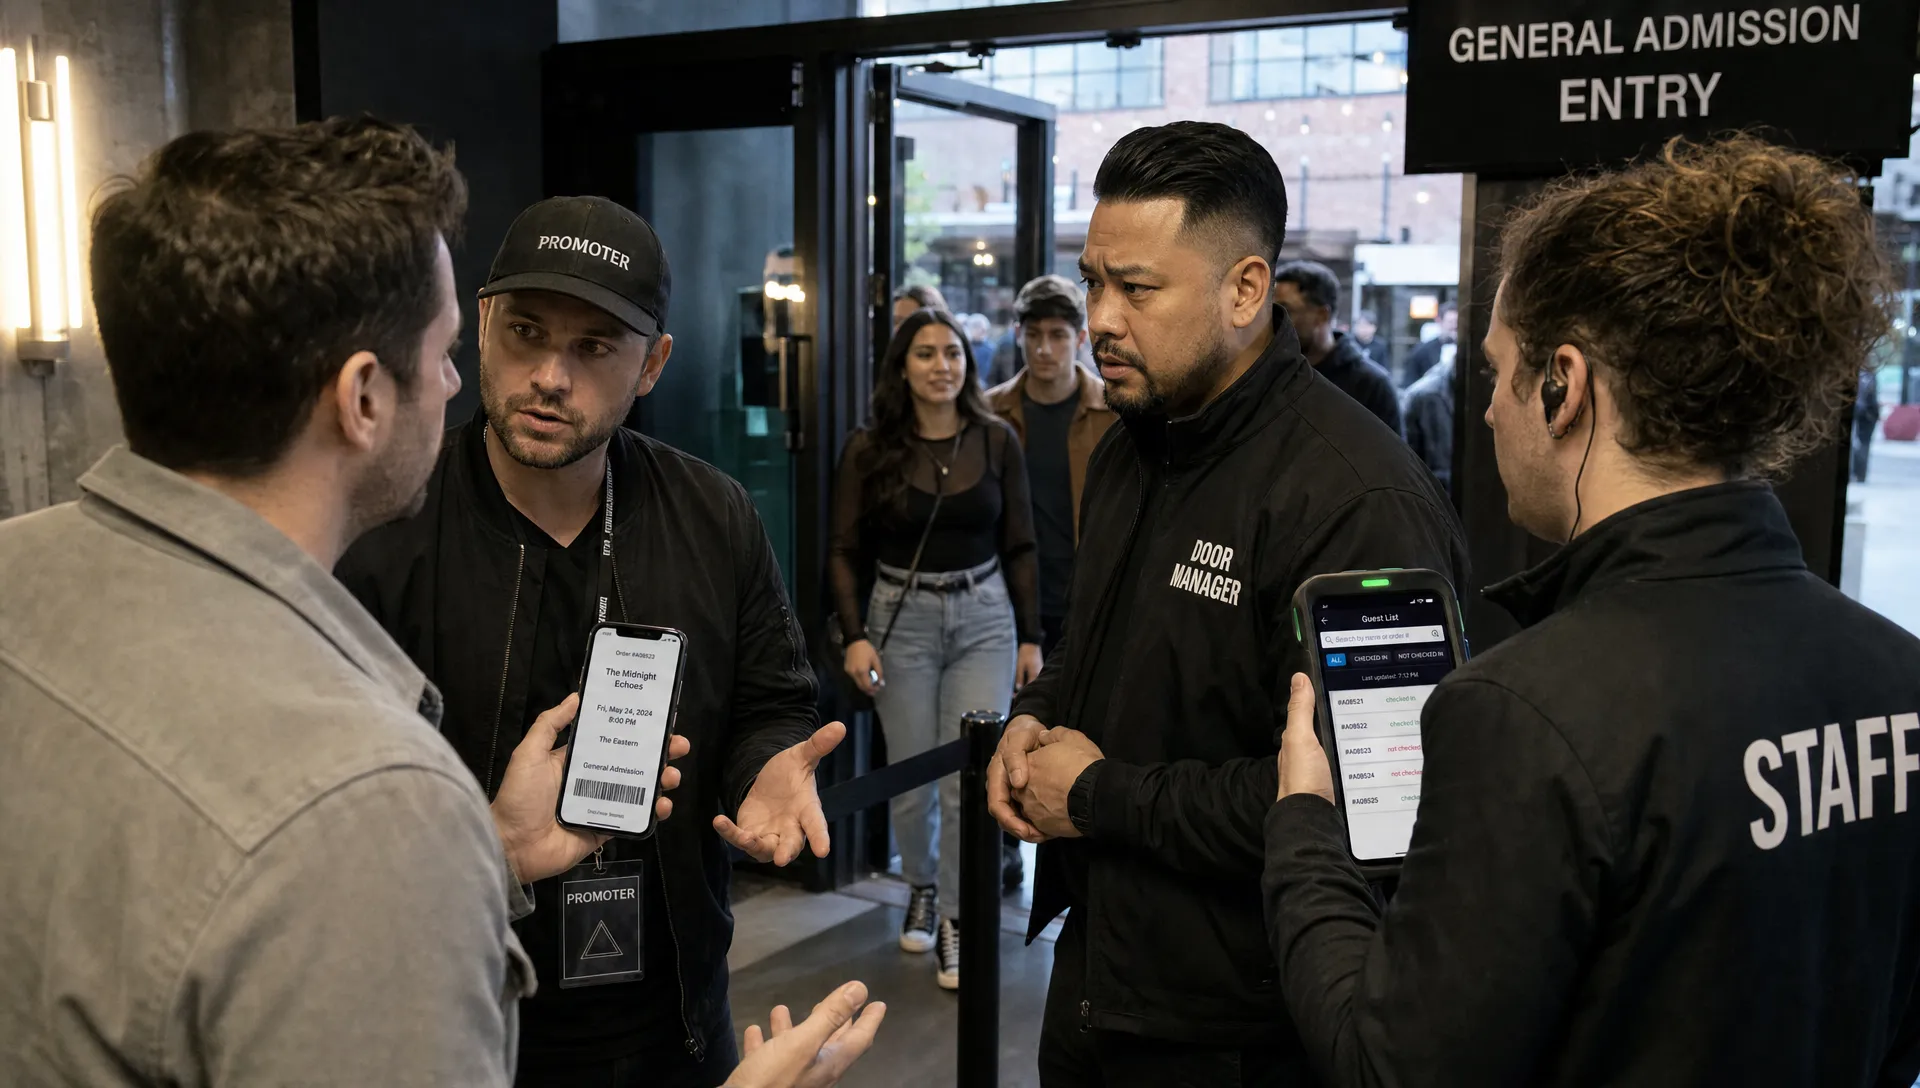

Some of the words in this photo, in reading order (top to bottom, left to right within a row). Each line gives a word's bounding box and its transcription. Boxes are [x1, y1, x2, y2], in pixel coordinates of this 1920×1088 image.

[1449, 19, 1625, 64] GENERAL
[1634, 4, 1860, 56] ADMISSION
[1559, 72, 1722, 123] ENTRY
[537, 235, 630, 271] PROMOTER
[1190, 539, 1234, 572] DOOR
[1169, 563, 1242, 606] MANAGER
[1361, 615, 1384, 623] Guest
[1385, 614, 1399, 622] List
[1357, 635, 1364, 643] by
[615, 650, 632, 658] Order
[1331, 656, 1342, 664] ALL
[605, 667, 621, 677] The
[622, 670, 657, 682] Midnight
[614, 680, 644, 691] Echoes
[596, 704, 608, 713] Fri,
[609, 706, 624, 715] May
[624, 708, 635, 717] 24,
[636, 709, 653, 717] 2024
[608, 716, 624, 725] 8:00
[625, 718, 637, 726] PM
[1390, 720, 1413, 728] checked
[599, 735, 611, 744] The
[612, 737, 639, 747] Eastern
[583, 762, 609, 772] General
[609, 765, 644, 776] Admission
[1743, 712, 1920, 850] STAFF
[567, 888, 635, 904] PROMOTER
